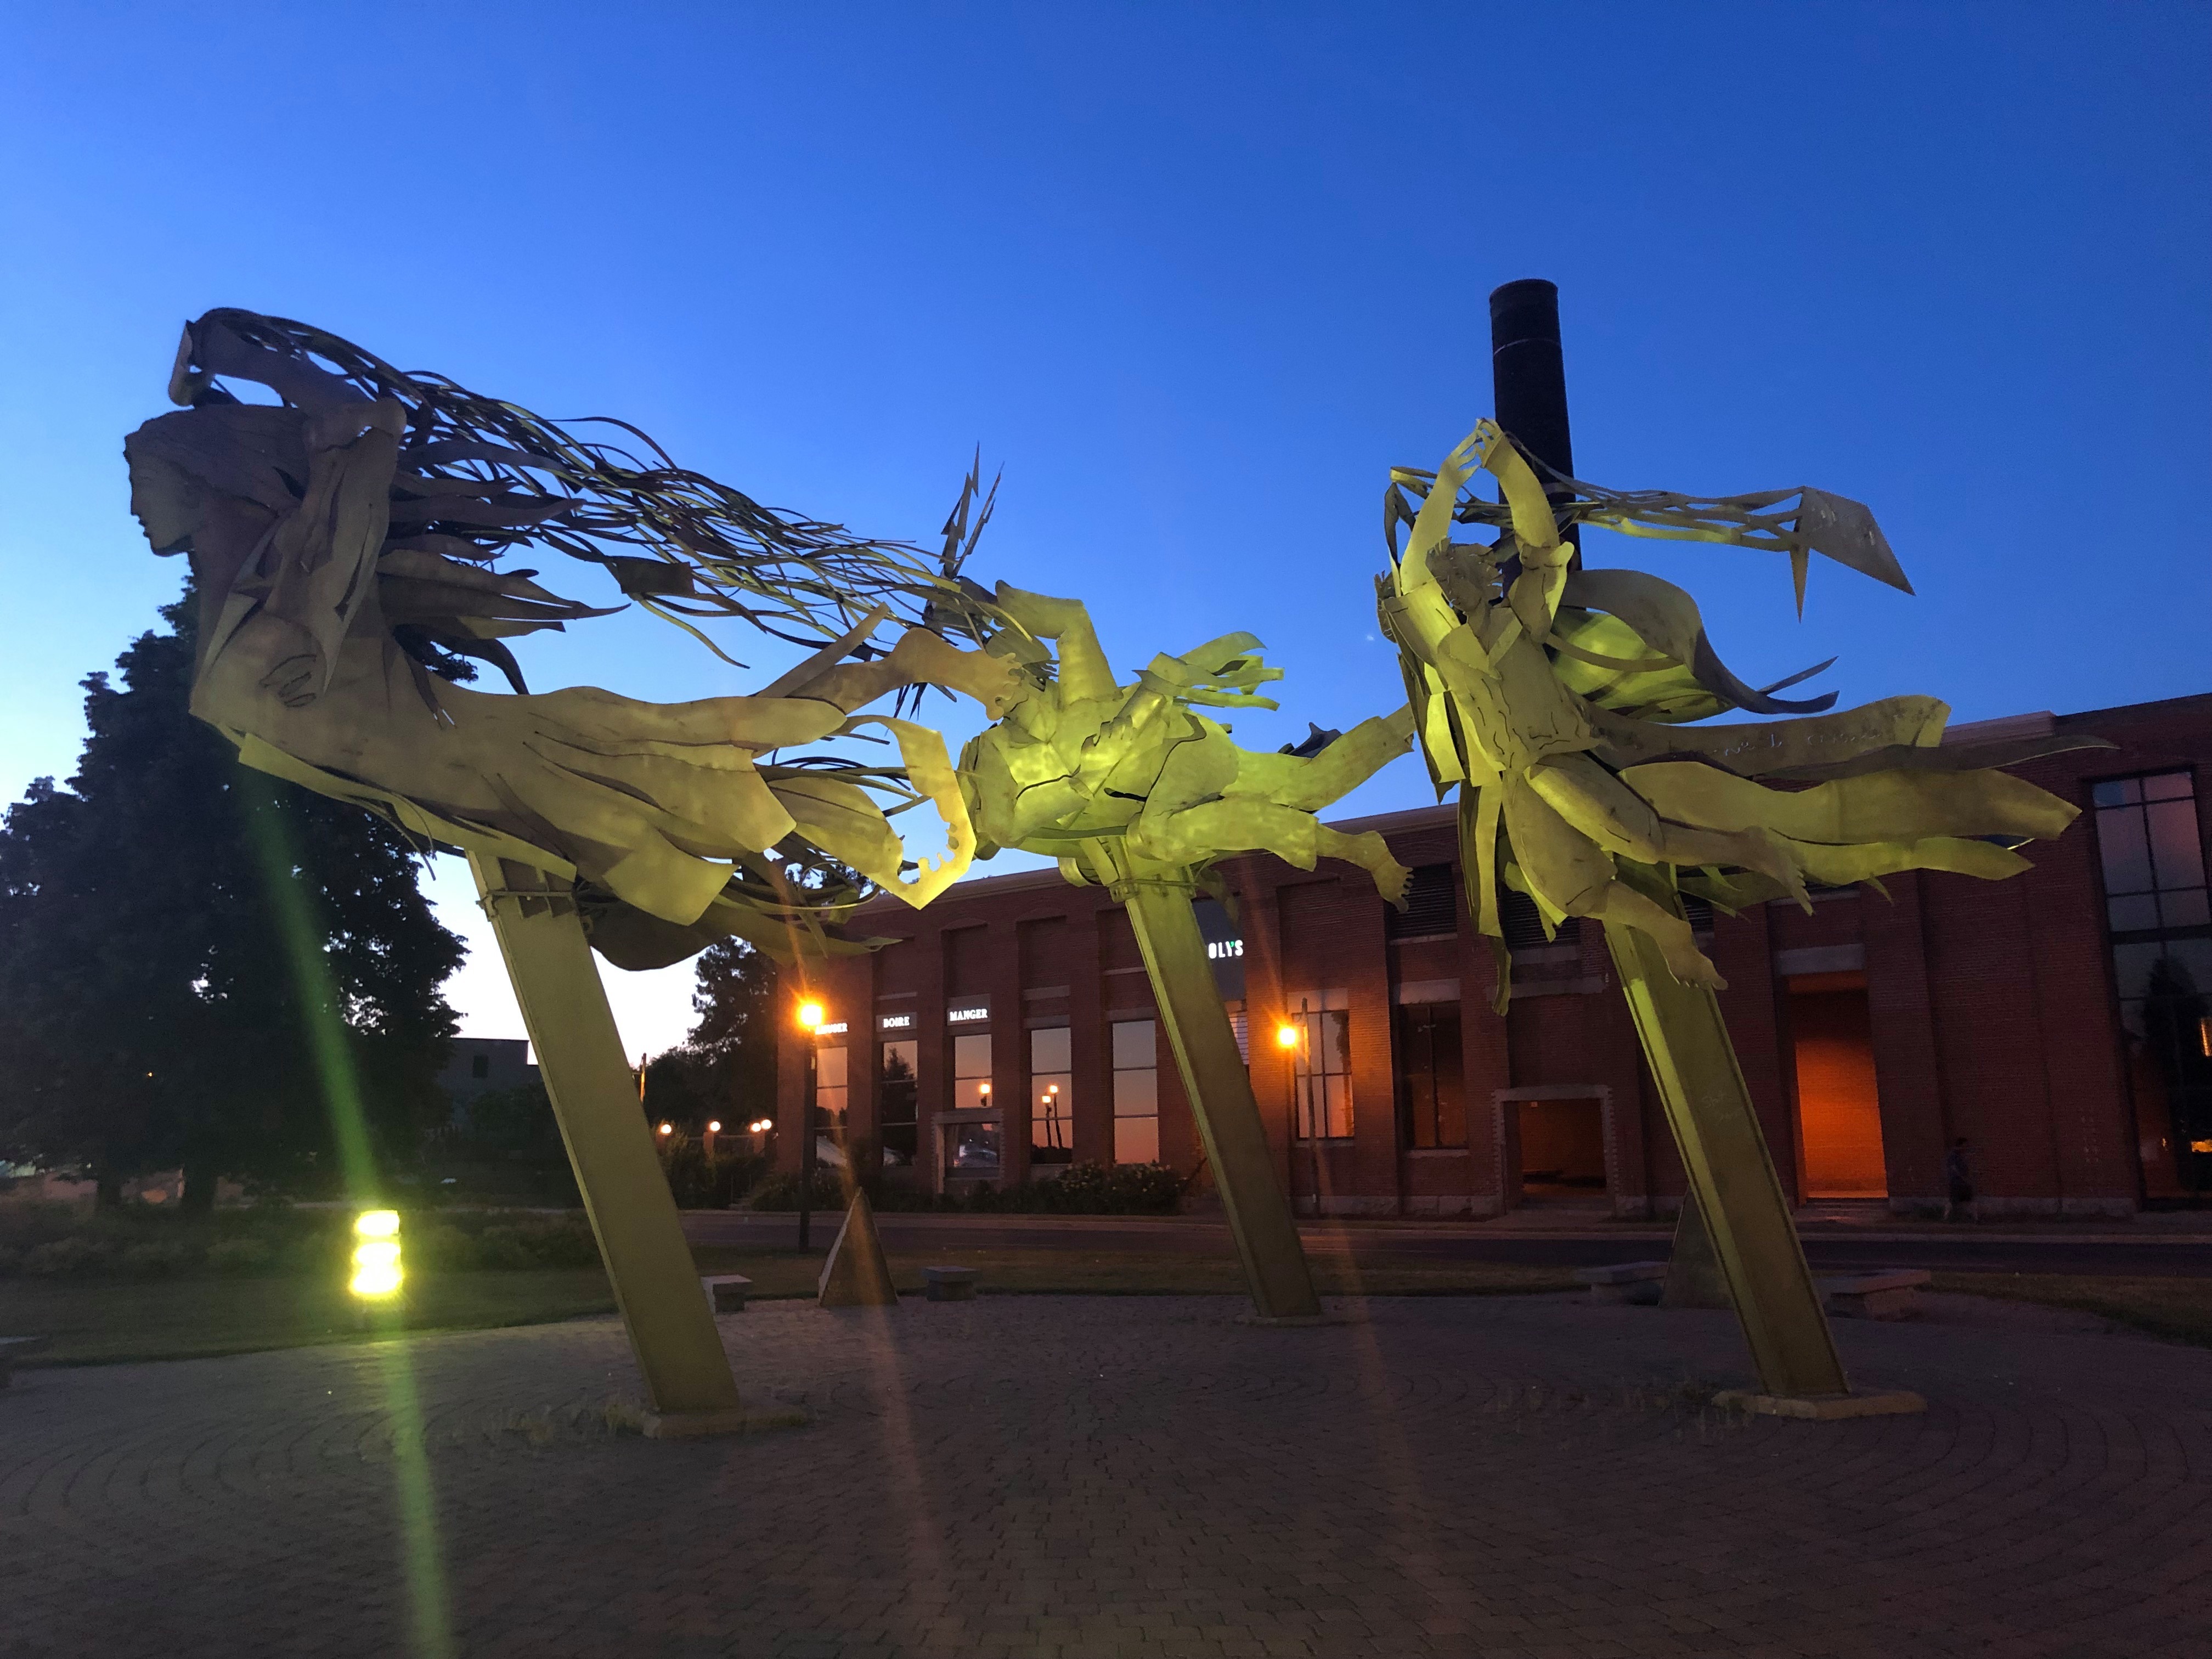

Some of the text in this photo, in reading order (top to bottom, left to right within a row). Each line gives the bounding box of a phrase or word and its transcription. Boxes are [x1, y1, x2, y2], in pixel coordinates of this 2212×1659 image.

[1209, 939, 1244, 959] OLY'S
[883, 1016, 910, 1028] BOIRE
[950, 1008, 988, 1022] MANGER
